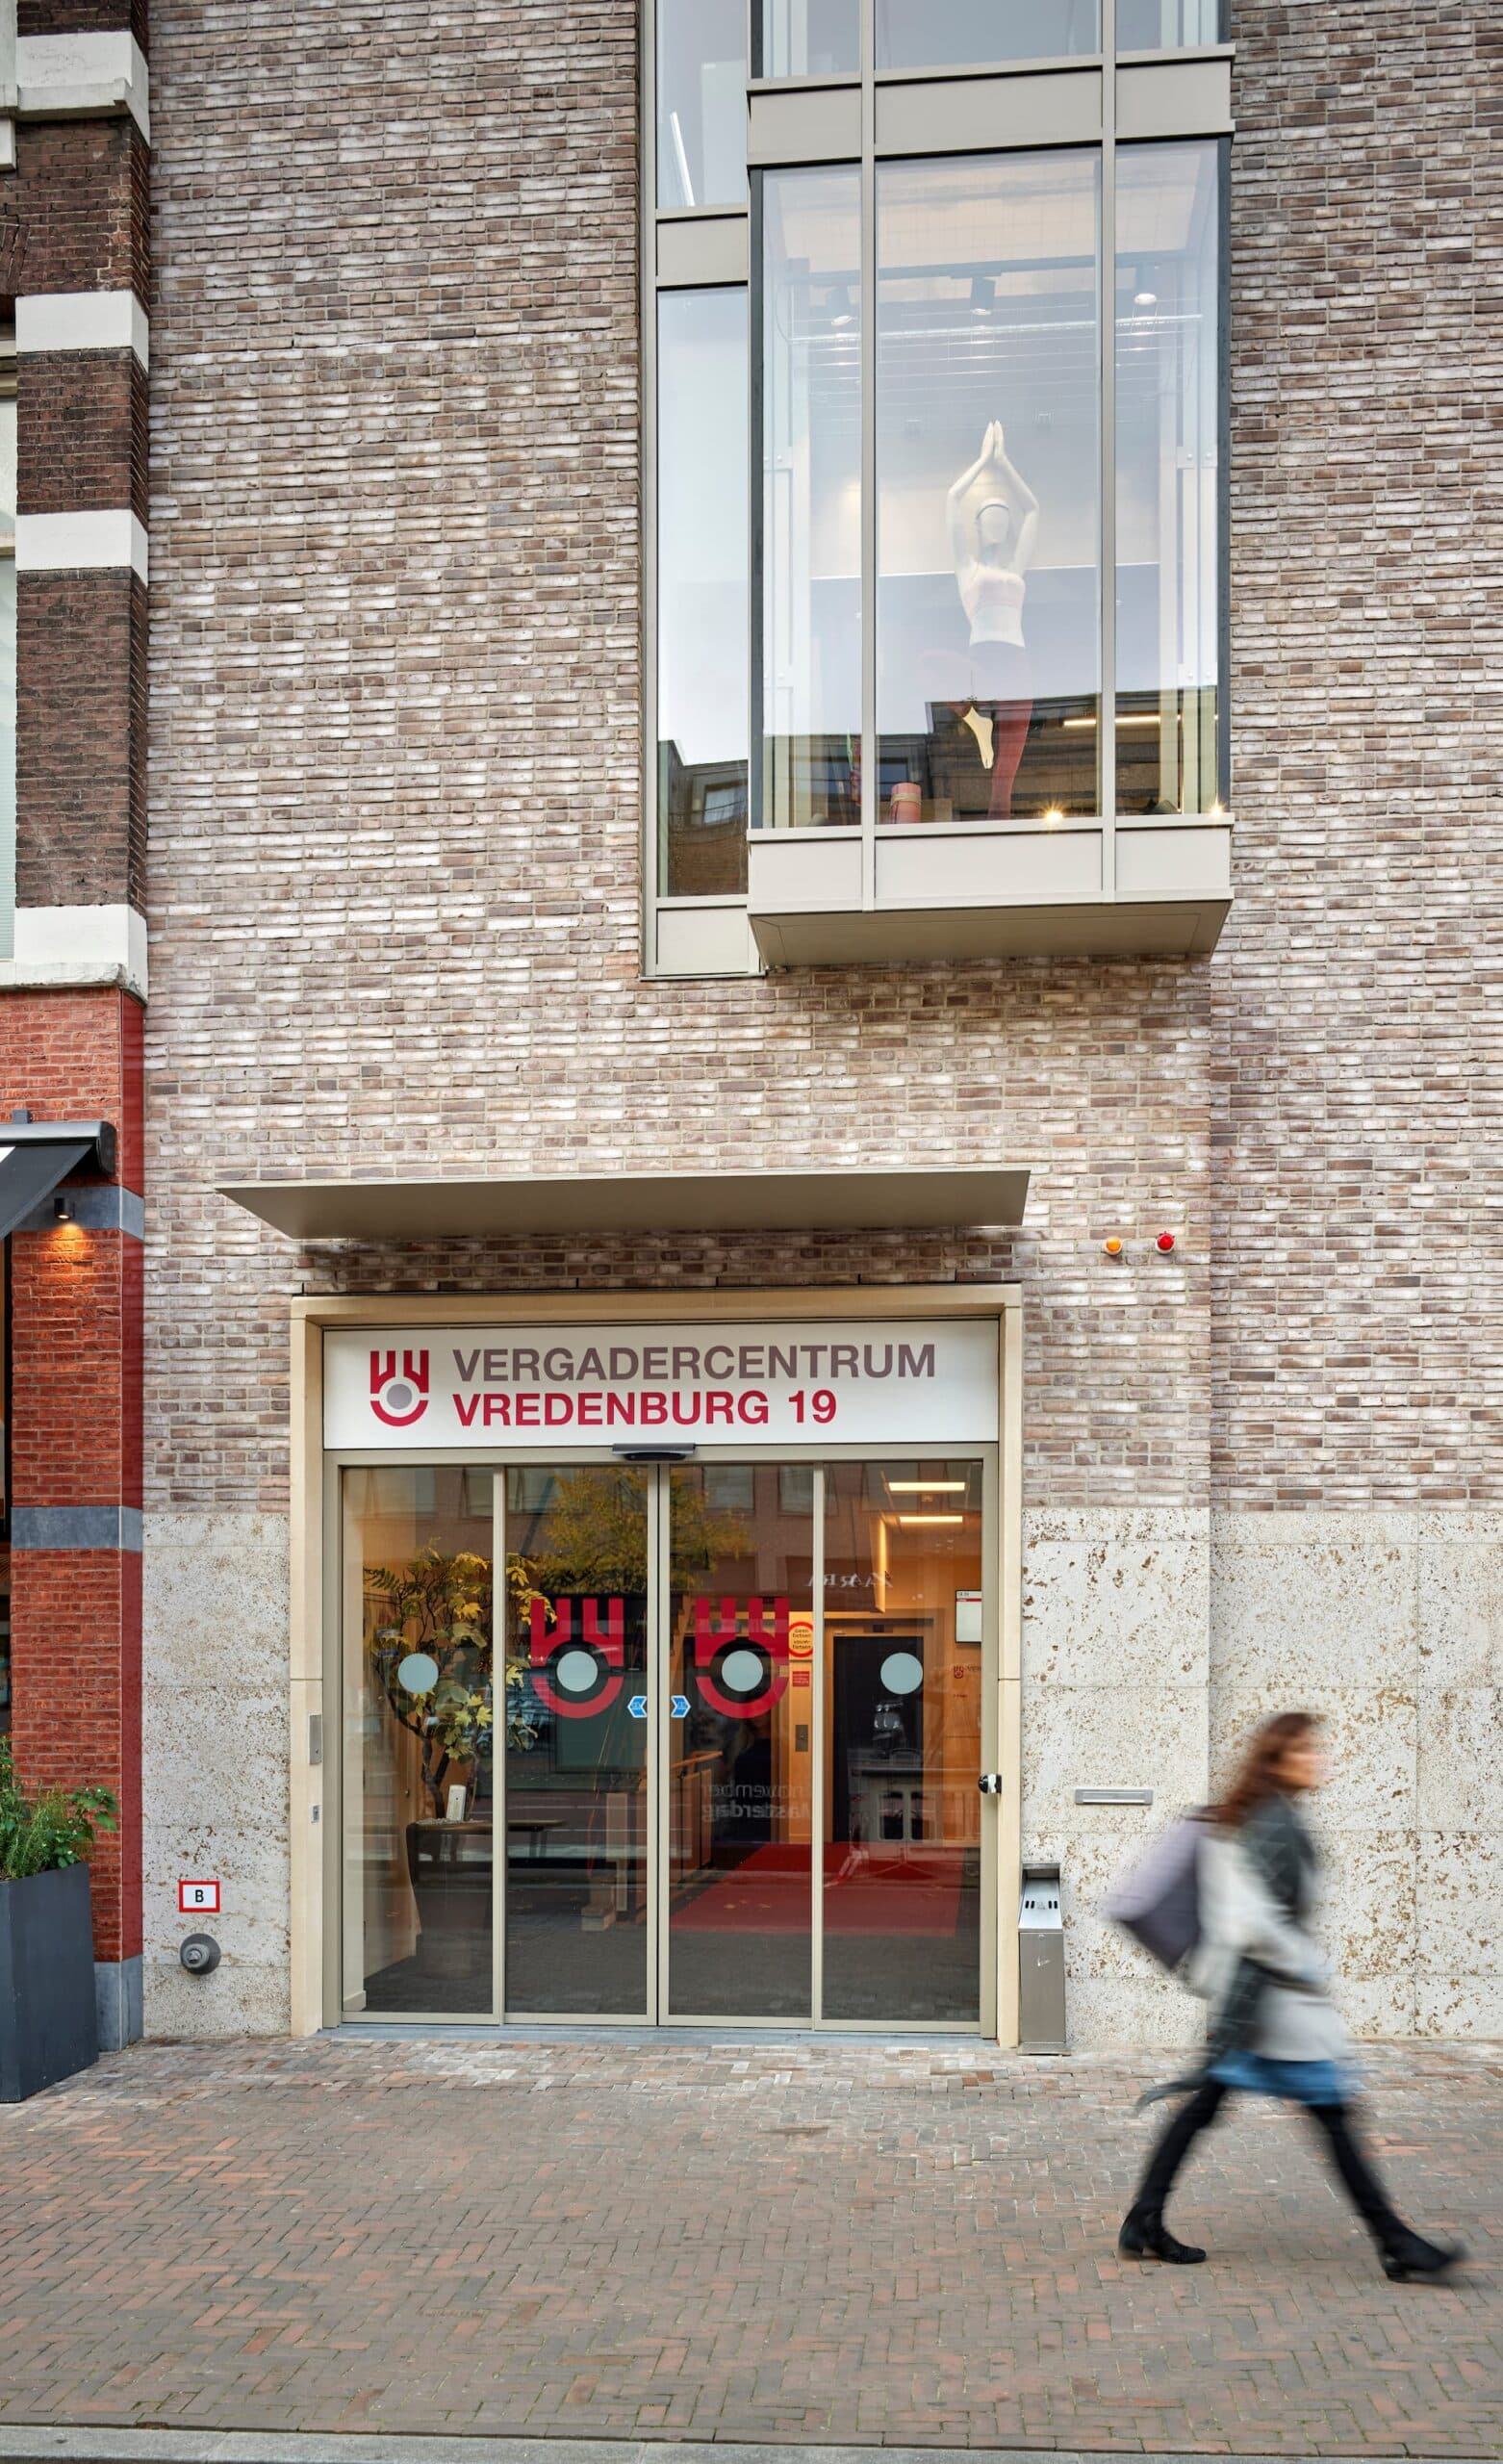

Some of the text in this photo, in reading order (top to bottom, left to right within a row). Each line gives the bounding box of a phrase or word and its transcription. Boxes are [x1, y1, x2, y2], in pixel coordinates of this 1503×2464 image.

[452, 1344, 935, 1382] VERGADERCENTRUM
[452, 1389, 837, 1426] VREDENBURG 19
[195, 1889, 204, 1902] B
